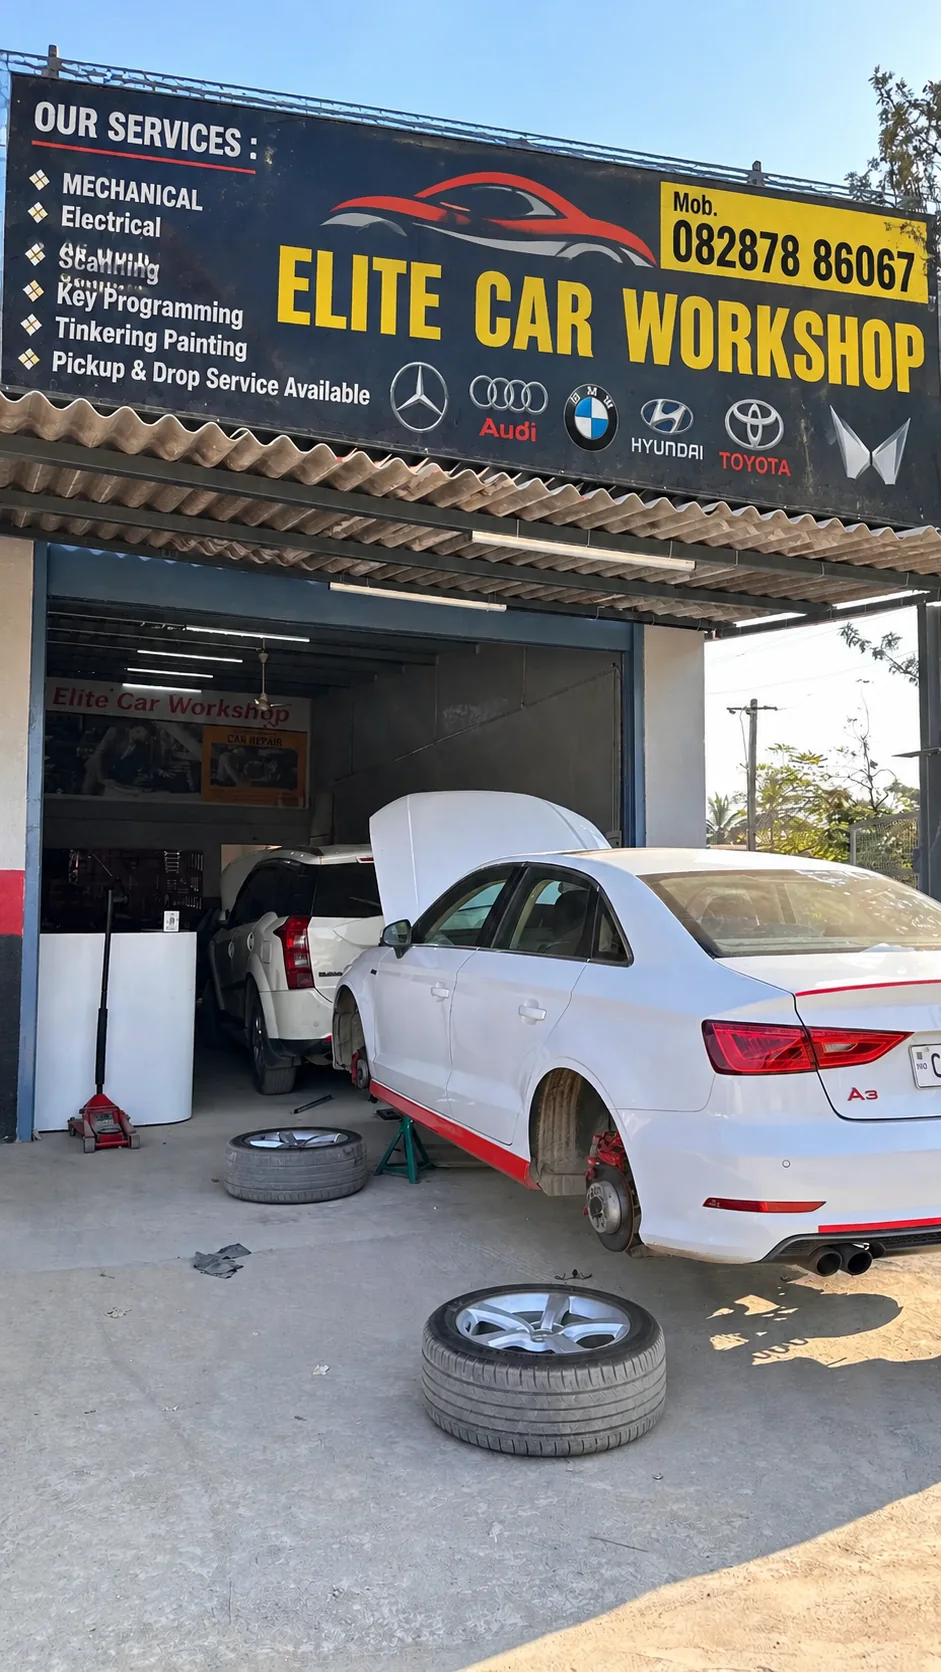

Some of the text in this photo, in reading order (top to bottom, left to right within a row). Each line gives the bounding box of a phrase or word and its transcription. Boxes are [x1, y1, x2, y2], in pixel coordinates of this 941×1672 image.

[34, 101, 98, 138] OUR
[107, 111, 241, 158] SERVICES
[62, 173, 203, 211] MECHANICAL
[673, 191, 718, 217] Mob.
[61, 205, 161, 238] Electrical
[673, 220, 915, 293] 082878 86067
[56, 281, 98, 312] Key
[103, 287, 243, 330] Programming
[277, 244, 926, 393] ELITE CAR WORKSHOP
[55, 316, 248, 362] Tinkering Painting
[52, 350, 371, 406] Pickup & Drop Service Available
[478, 417, 537, 443] Audi
[630, 436, 703, 461] HYUNDAI
[719, 451, 791, 478] TOYOTA
[53, 686, 290, 723] Elite Car Workshop
[227, 734, 283, 747] CAR REPAIR
[847, 1087, 879, 1101] A3
